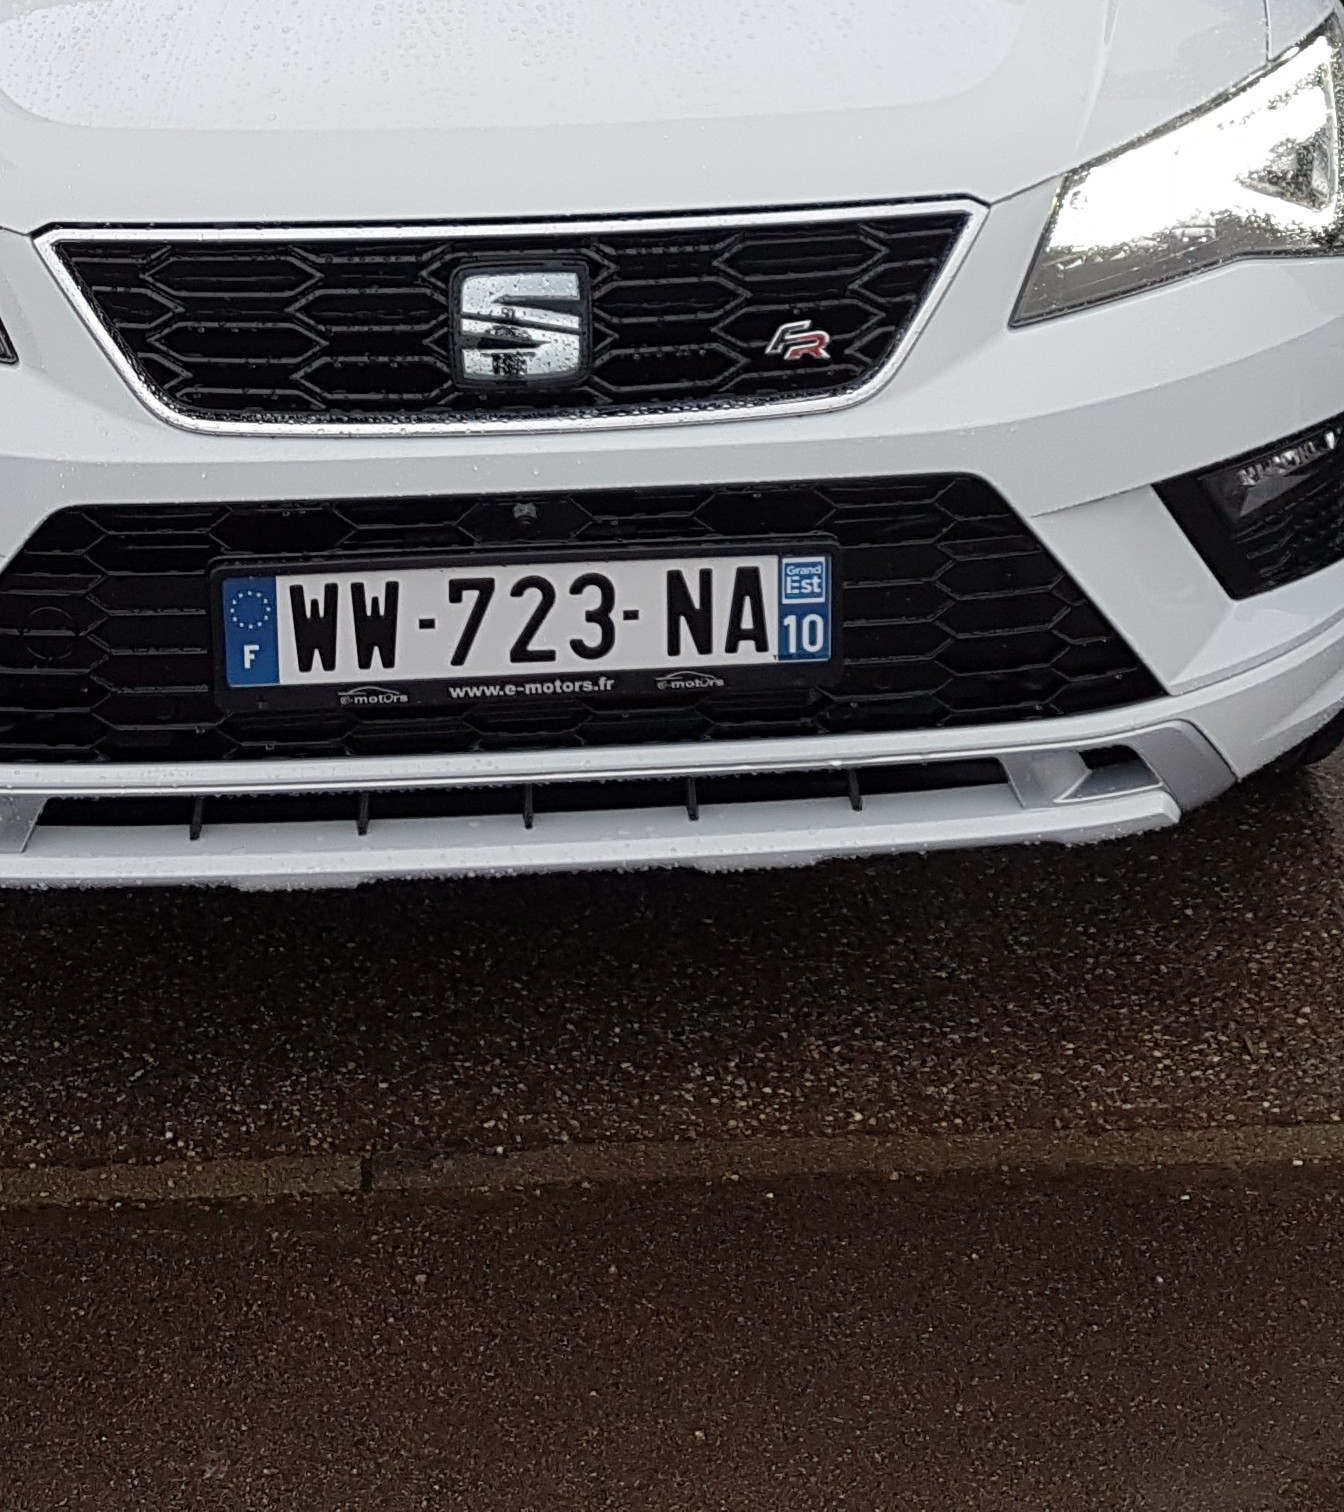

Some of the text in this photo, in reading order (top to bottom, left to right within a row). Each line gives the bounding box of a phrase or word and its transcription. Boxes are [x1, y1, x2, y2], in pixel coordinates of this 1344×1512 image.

[765, 319, 832, 361] FR
[786, 564, 822, 576] Grand
[786, 575, 822, 594] Est
[783, 613, 824, 654] 10
[243, 644, 260, 669] F
[448, 676, 615, 699] www.e-motors.fr
